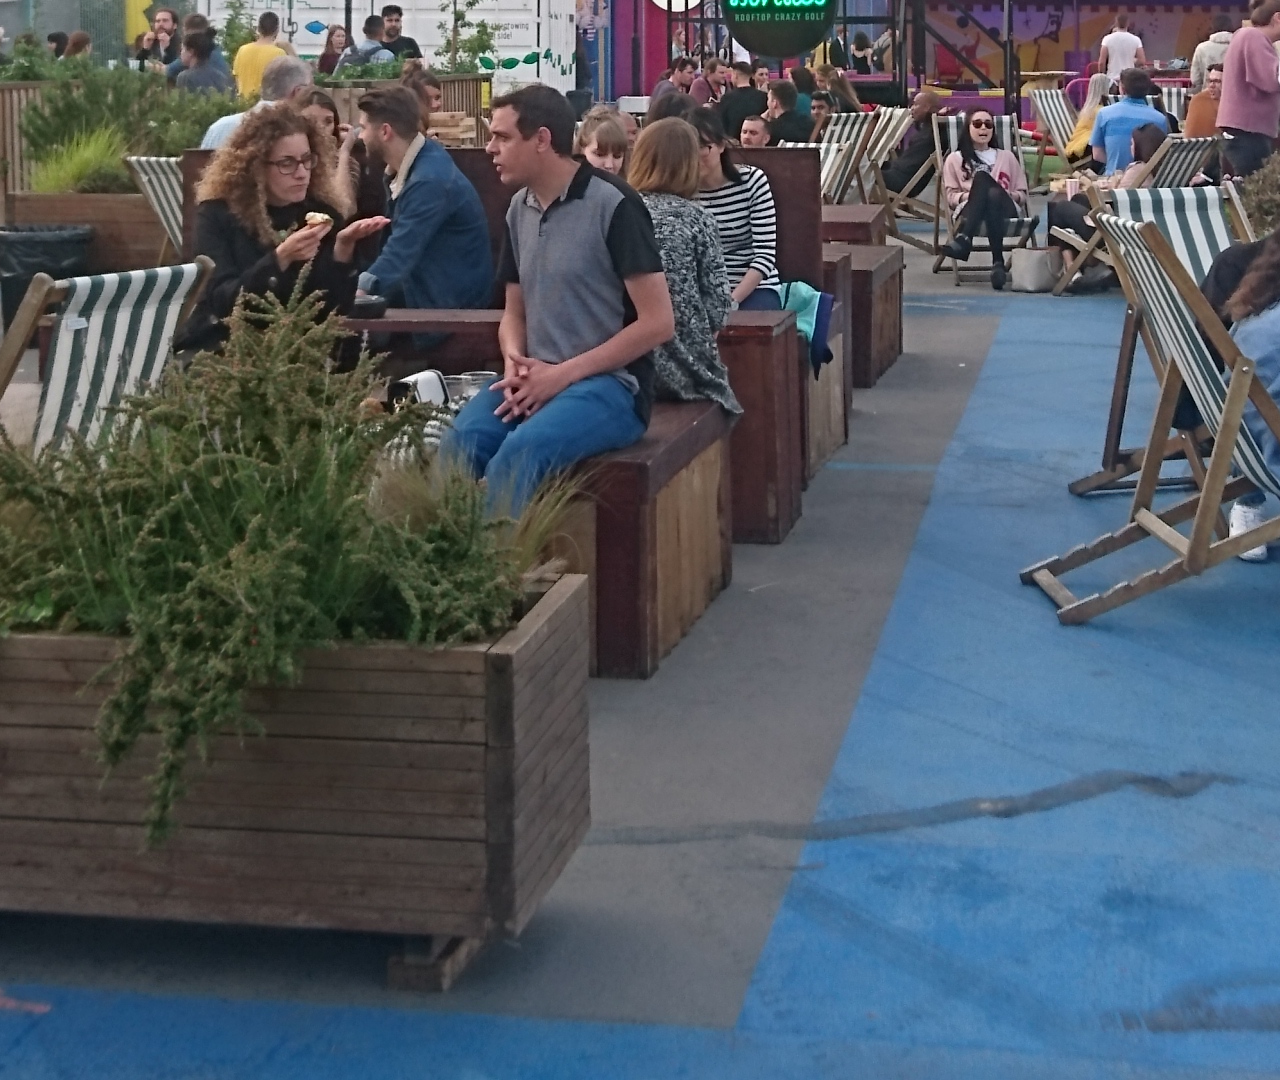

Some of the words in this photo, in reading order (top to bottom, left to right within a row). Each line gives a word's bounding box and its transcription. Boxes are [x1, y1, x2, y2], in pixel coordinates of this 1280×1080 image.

[734, 13, 771, 22] ROOFTOP
[775, 12, 801, 21] CRAZY
[805, 12, 825, 21] GOLF
